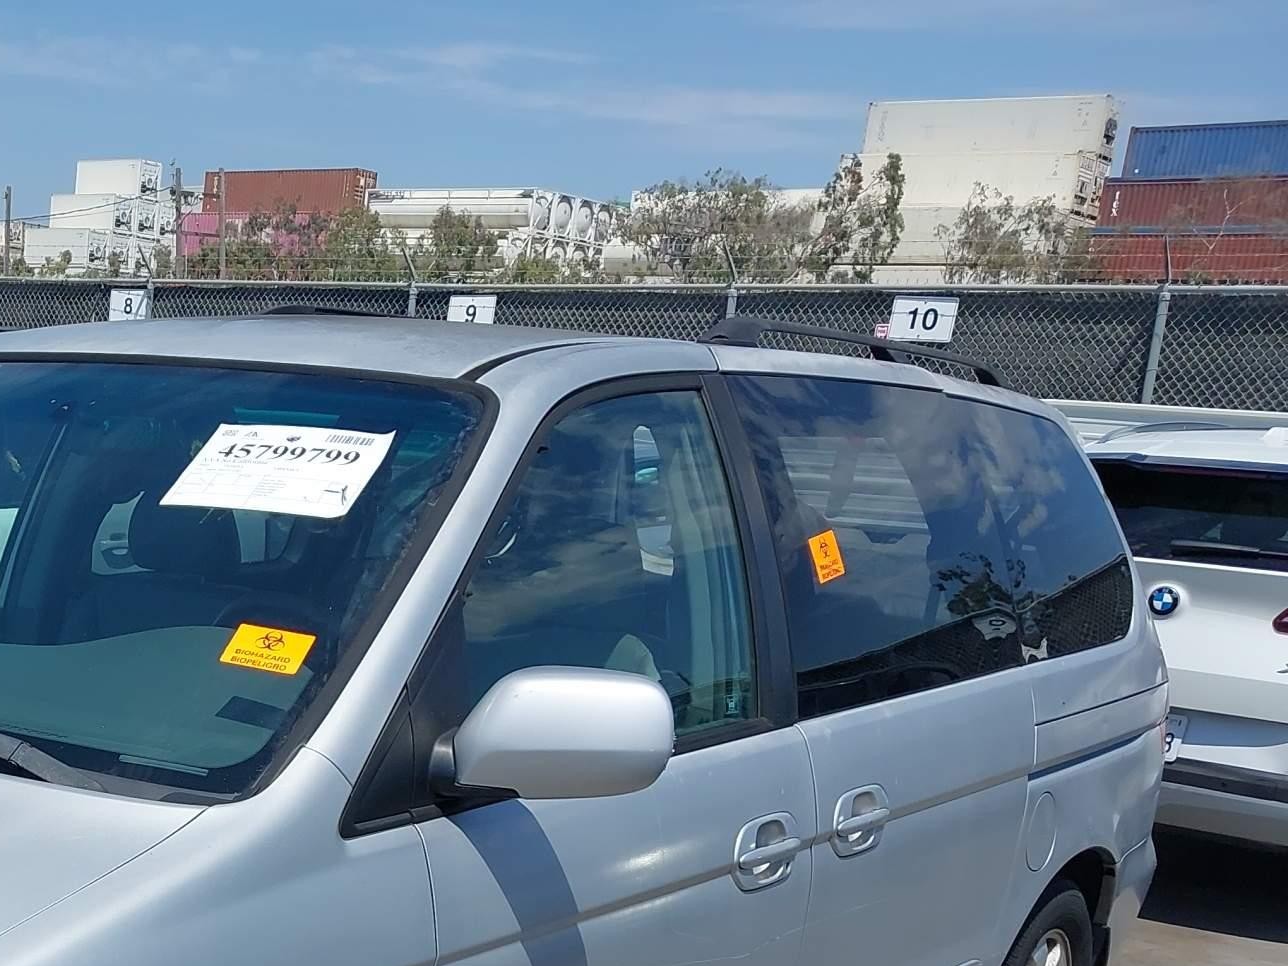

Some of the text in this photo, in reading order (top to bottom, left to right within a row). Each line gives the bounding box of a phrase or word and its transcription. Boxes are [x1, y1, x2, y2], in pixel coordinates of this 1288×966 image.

[123, 297, 133, 314] 8
[465, 304, 477, 323] 9
[907, 307, 939, 331] 10
[218, 442, 361, 466] 45799799
[230, 655, 288, 671] BIOPELIGRO
[234, 648, 292, 664] BIOHAZARD
